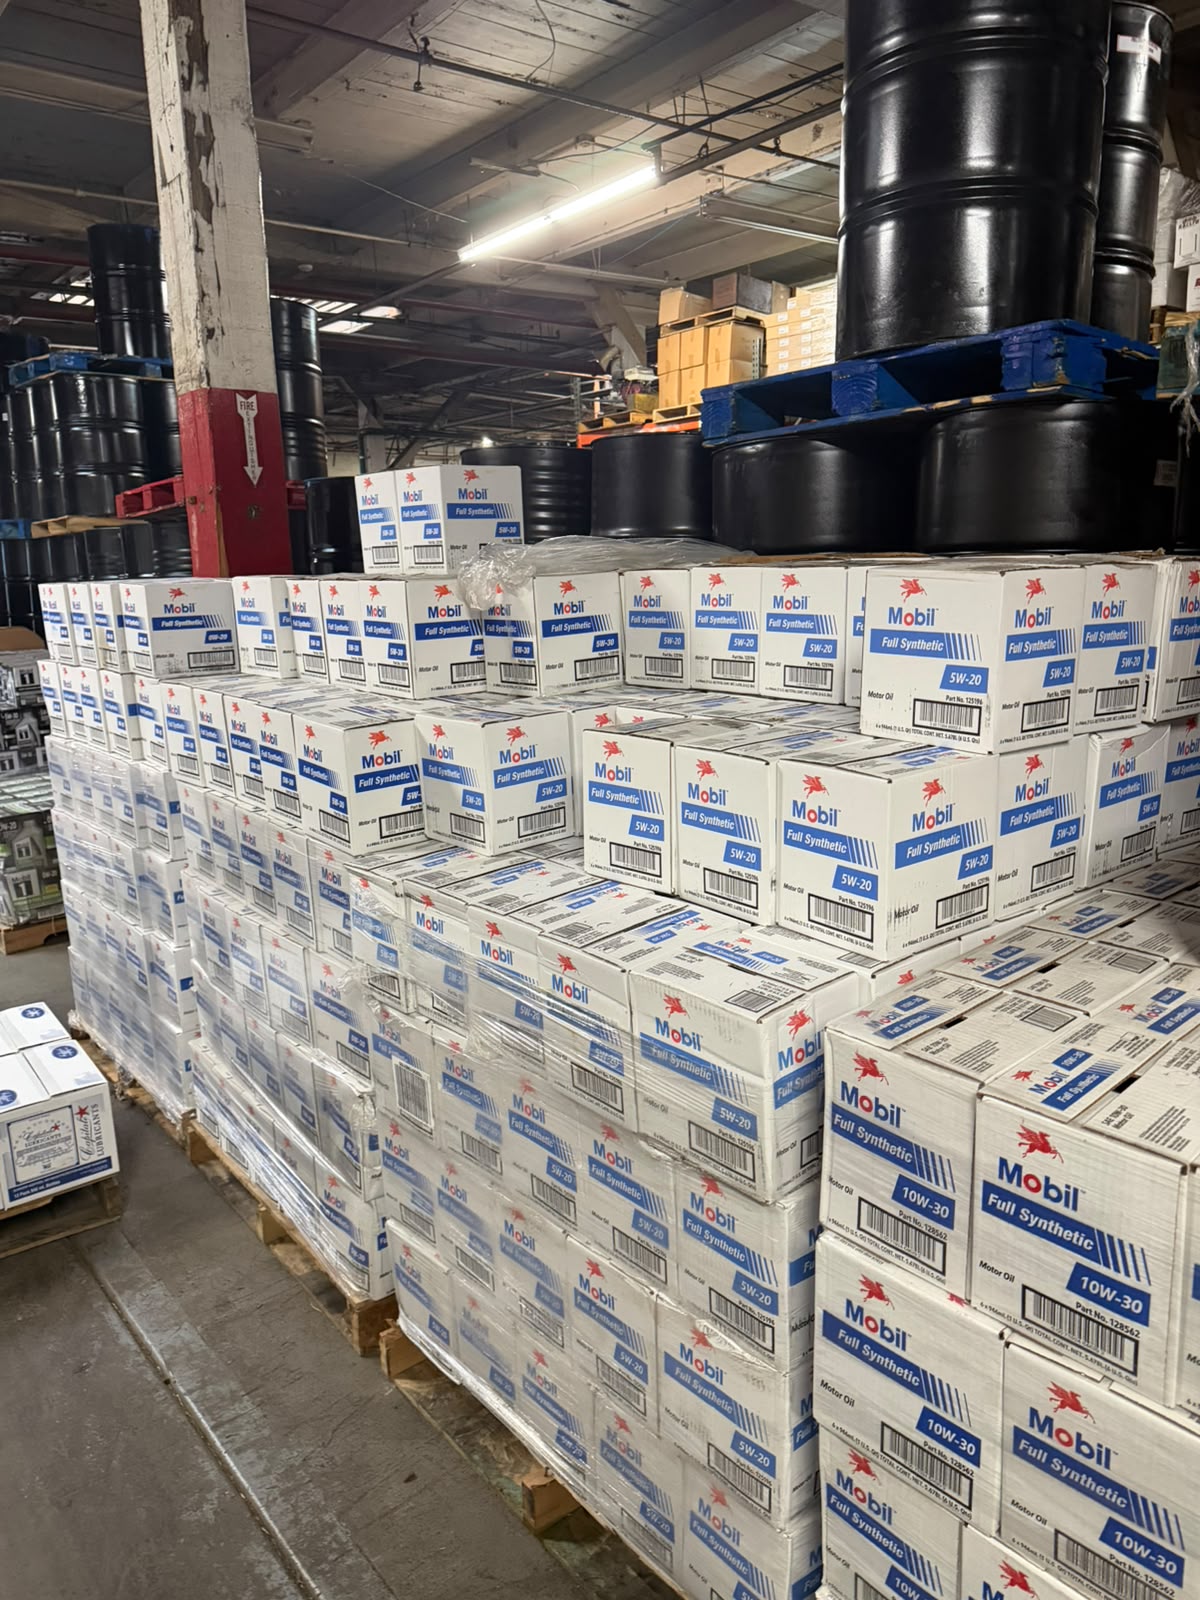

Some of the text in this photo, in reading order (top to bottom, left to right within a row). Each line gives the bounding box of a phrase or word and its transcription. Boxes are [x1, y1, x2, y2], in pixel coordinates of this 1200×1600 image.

[240, 401, 255, 411] FIRE
[362, 494, 378, 505] Mobil
[404, 490, 422, 502] Mobil
[458, 488, 487, 500] Mobil
[402, 508, 428, 518] Full Synthetic
[456, 507, 494, 516] Full Synthetic
[164, 604, 195, 614] Mobil
[240, 598, 255, 608] Mobil
[292, 602, 306, 613] Mobil
[328, 604, 344, 616] Mobil
[554, 601, 584, 615] Mobil
[633, 595, 660, 608] Mobil
[701, 594, 732, 607] Mobil
[366, 606, 386, 618] Mobil
[428, 606, 461, 618] Mobil
[641, 616, 666, 624] Synthetic
[708, 616, 738, 625] Synthetic
[888, 607, 934, 626] Mobil
[1014, 607, 1051, 628] Mobil
[424, 625, 469, 636] Full Synthetic
[551, 621, 592, 632] Full Synthetic
[1085, 630, 1128, 642] Full Synthetic
[664, 637, 681, 646] 5W-20
[733, 638, 754, 648] 5W-20
[810, 644, 832, 653] 5W-20
[882, 636, 944, 651] Full Synthetic
[1009, 640, 1056, 654] Full Synthetic
[950, 672, 982, 686] 5W-20
[868, 690, 894, 700] Motor Oil
[231, 720, 246, 733] Mobil
[261, 731, 278, 746] Mobil
[304, 744, 322, 762] Mobil
[362, 750, 400, 768] Mobil
[429, 744, 453, 760] Mobil
[500, 745, 536, 764] Mobil
[311, 768, 328, 780] Synthetic
[428, 765, 460, 780] Full Synthetic
[497, 767, 544, 783] Full Synthetic
[1112, 757, 1136, 778] Mobil
[359, 772, 410, 788] Full Synthetic
[542, 784, 562, 796] 5W-20
[1016, 778, 1049, 802] Mobil
[466, 794, 482, 806] 5W-20
[591, 788, 640, 804] Full Synthetic
[688, 783, 726, 805] Mobil
[684, 809, 734, 830] Full Synthetic
[792, 800, 838, 827] Mobil
[912, 806, 952, 832] Mobil
[1010, 806, 1054, 827] Full Synthetic
[635, 821, 660, 834] 5W-20
[787, 830, 847, 854] Full Synthetic
[907, 834, 960, 859] Full Synthetic
[730, 850, 756, 863] 5W-20
[784, 883, 797, 892] Motor
[417, 912, 444, 934] Mobil
[480, 940, 513, 965] Mobil
[552, 974, 588, 1004] Mobil
[656, 1017, 700, 1051] Mobil
[778, 1030, 822, 1071] Mobil
[446, 1059, 474, 1082] Mobil
[653, 1045, 712, 1081] Full Synthetic
[1028, 1070, 1069, 1094] Mobil
[512, 1094, 546, 1123] Mobil
[841, 1081, 901, 1128] Mobil
[91, 1103, 104, 1156] LUBRICANTS
[511, 1117, 555, 1149] Full Synthetic
[834, 1114, 912, 1163] Full Synthetic
[594, 1140, 632, 1174] Mobil
[592, 1165, 642, 1200] Full Synthetic
[998, 1156, 1079, 1212] Mobil
[690, 1192, 735, 1233] Mobil
[898, 1210, 912, 1222] Part
[912, 1214, 924, 1227] No.
[987, 1193, 1094, 1252] Full Synthetic
[504, 1220, 535, 1250] Mobil
[686, 1215, 746, 1262] Full Synthetic
[979, 1260, 1015, 1283] Motor Oil
[579, 1274, 615, 1310] Mobil
[740, 1280, 772, 1306] 5W-20
[1080, 1276, 1142, 1315] 10W-30
[846, 1298, 906, 1352] Mobil
[1076, 1302, 1141, 1338] Part No. 128562
[1034, 1328, 1052, 1340] TOTAL
[620, 1351, 644, 1376] 5W-20
[680, 1343, 724, 1386] Mobil
[837, 1328, 921, 1387] Full Synthetic
[675, 1367, 732, 1414] Full Synthetic
[820, 1380, 855, 1407] Motor Oil
[607, 1426, 642, 1467] Mobil
[927, 1417, 976, 1456] 10W-30
[1029, 1407, 1112, 1470] Mobil
[924, 1440, 937, 1454] Part
[938, 1448, 949, 1462] No.
[1018, 1438, 1128, 1510] Full Synthetic
[836, 1468, 893, 1526] Mobil
[698, 1498, 740, 1546] Mobil
[1011, 1499, 1048, 1526] Motor Oil
[830, 1494, 904, 1559] Full Synthetic
[692, 1520, 748, 1574] Full Synthetic
[1114, 1530, 1178, 1576] 10W-30
[1110, 1554, 1128, 1568] Part
[1128, 1564, 1142, 1578] No.
